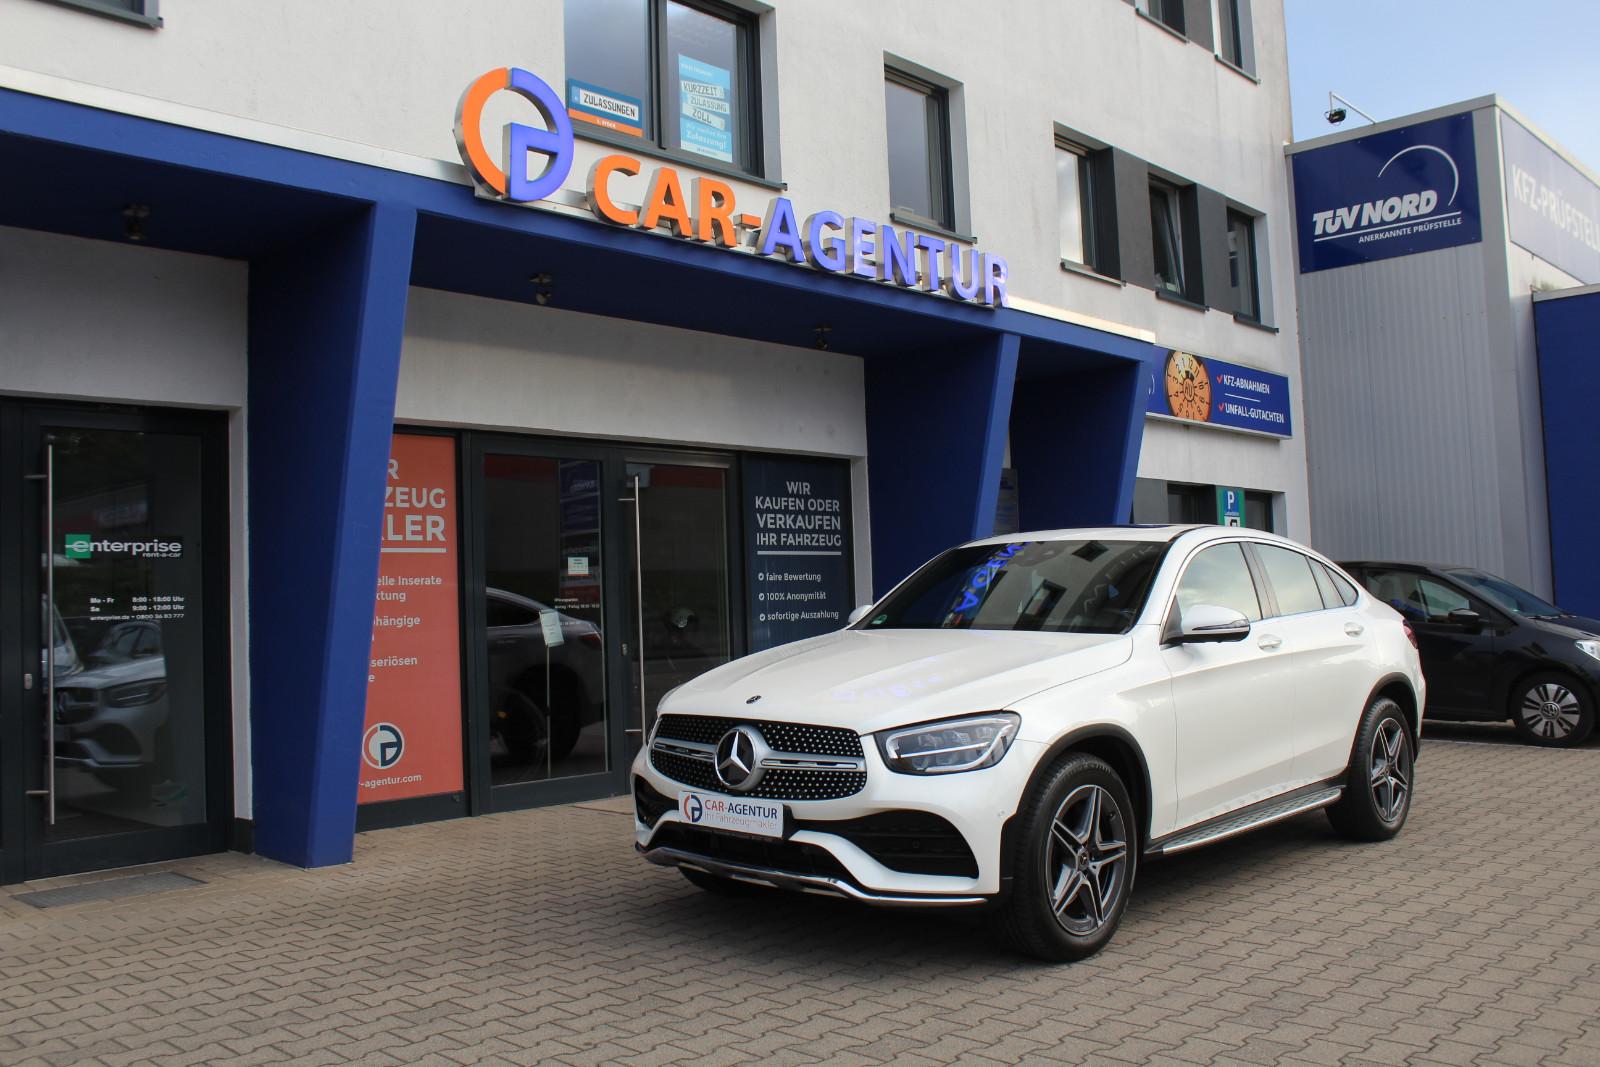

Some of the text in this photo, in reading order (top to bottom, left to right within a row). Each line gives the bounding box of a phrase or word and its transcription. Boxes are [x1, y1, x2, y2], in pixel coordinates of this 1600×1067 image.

[683, 82, 718, 97] KURZZEIT
[583, 93, 636, 118] ZULASSUNGEN
[690, 96, 727, 113] ZULASSUNG
[692, 108, 712, 124] ZOLL
[1313, 189, 1438, 235] TÜV NORD
[587, 154, 1010, 308] CAR-AGENTUR
[1358, 216, 1462, 244] ANERKANNTE PRÜFSTELLE
[1223, 374, 1270, 395] KFZ-ABNAHMEN
[1225, 403, 1284, 424] UNFALL-GUTACHTEN
[786, 481, 811, 495] WIR
[384, 486, 446, 509] ZEUG
[755, 496, 840, 512] KAUFEN ODER
[1227, 490, 1235, 510] P
[382, 514, 446, 541] LER
[756, 513, 841, 530] VERKAUFEN
[70, 538, 182, 556] enterprise
[756, 532, 842, 547] IHR FAHRZEUG
[398, 575, 442, 586] Inserate
[766, 572, 822, 582] faire Bewertung
[767, 591, 827, 602] 100% Anonymität
[373, 613, 421, 628] hängige
[767, 610, 839, 622] sofortige Auszahlung
[371, 656, 418, 668] seriösen
[359, 774, 422, 789] -agentur.com
[704, 799, 778, 819] CAR-AGENTUR
[714, 813, 778, 830] ahrzeugakler
